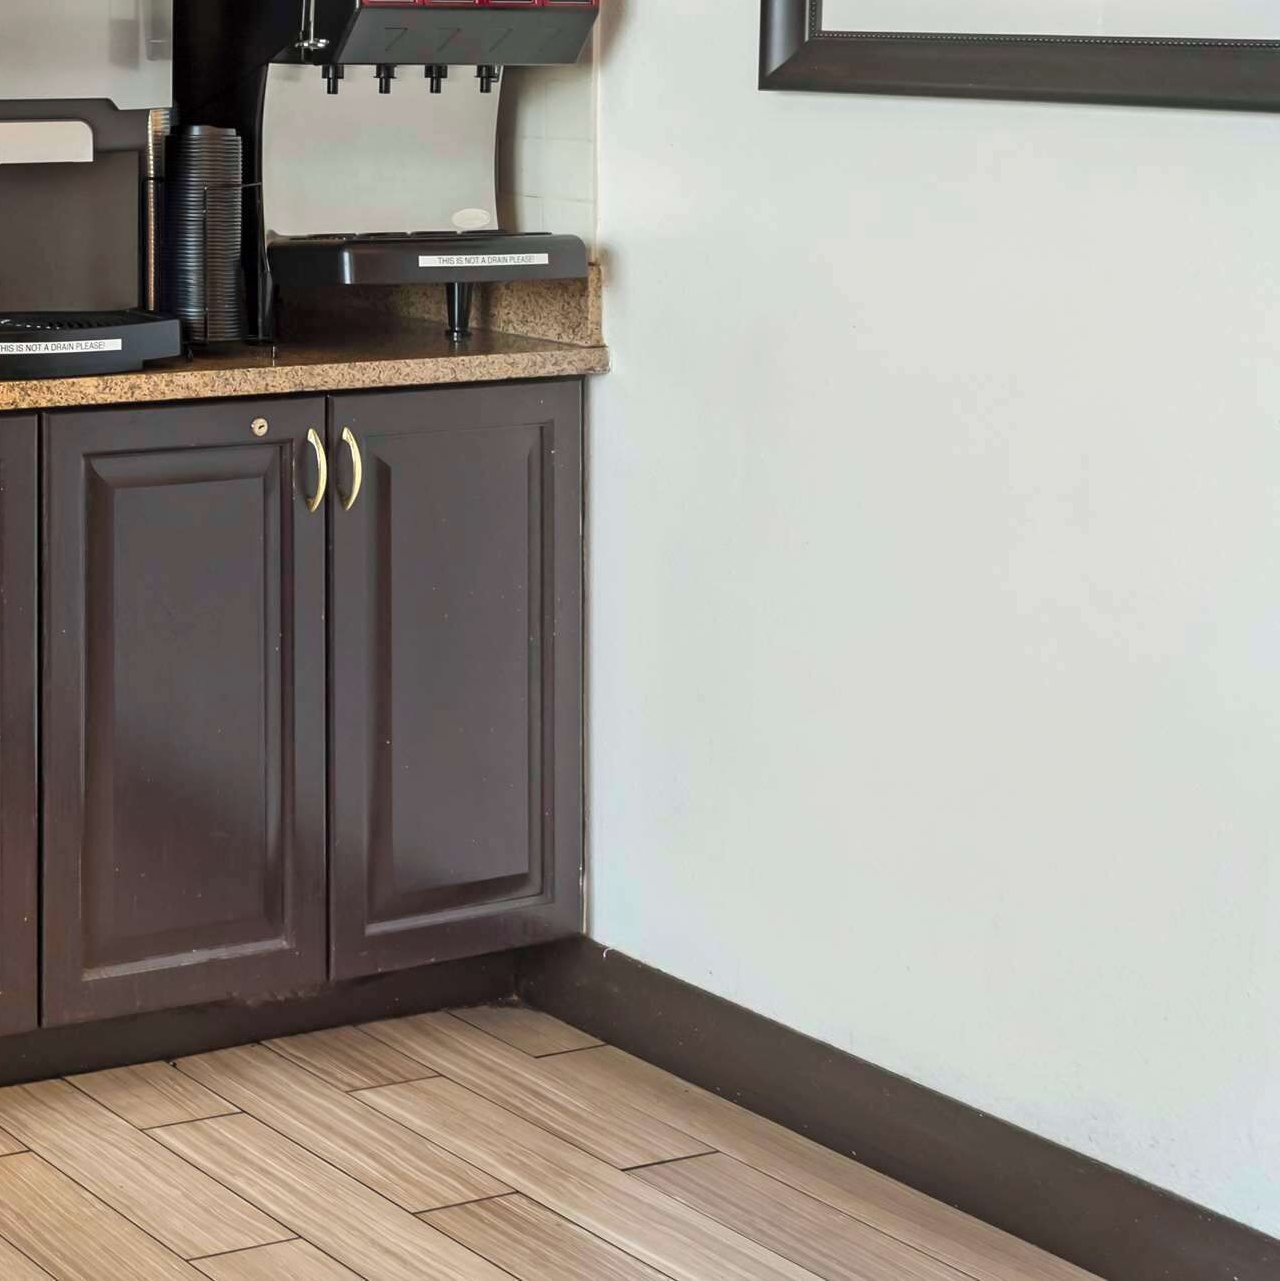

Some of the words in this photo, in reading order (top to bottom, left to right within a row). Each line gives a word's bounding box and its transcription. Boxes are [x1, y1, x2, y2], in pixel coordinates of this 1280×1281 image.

[437, 257, 455, 265] THIS
[16, 344, 23, 352] IS
[26, 344, 42, 352] NOT
[43, 343, 50, 351] A
[51, 343, 74, 351] DRAIN
